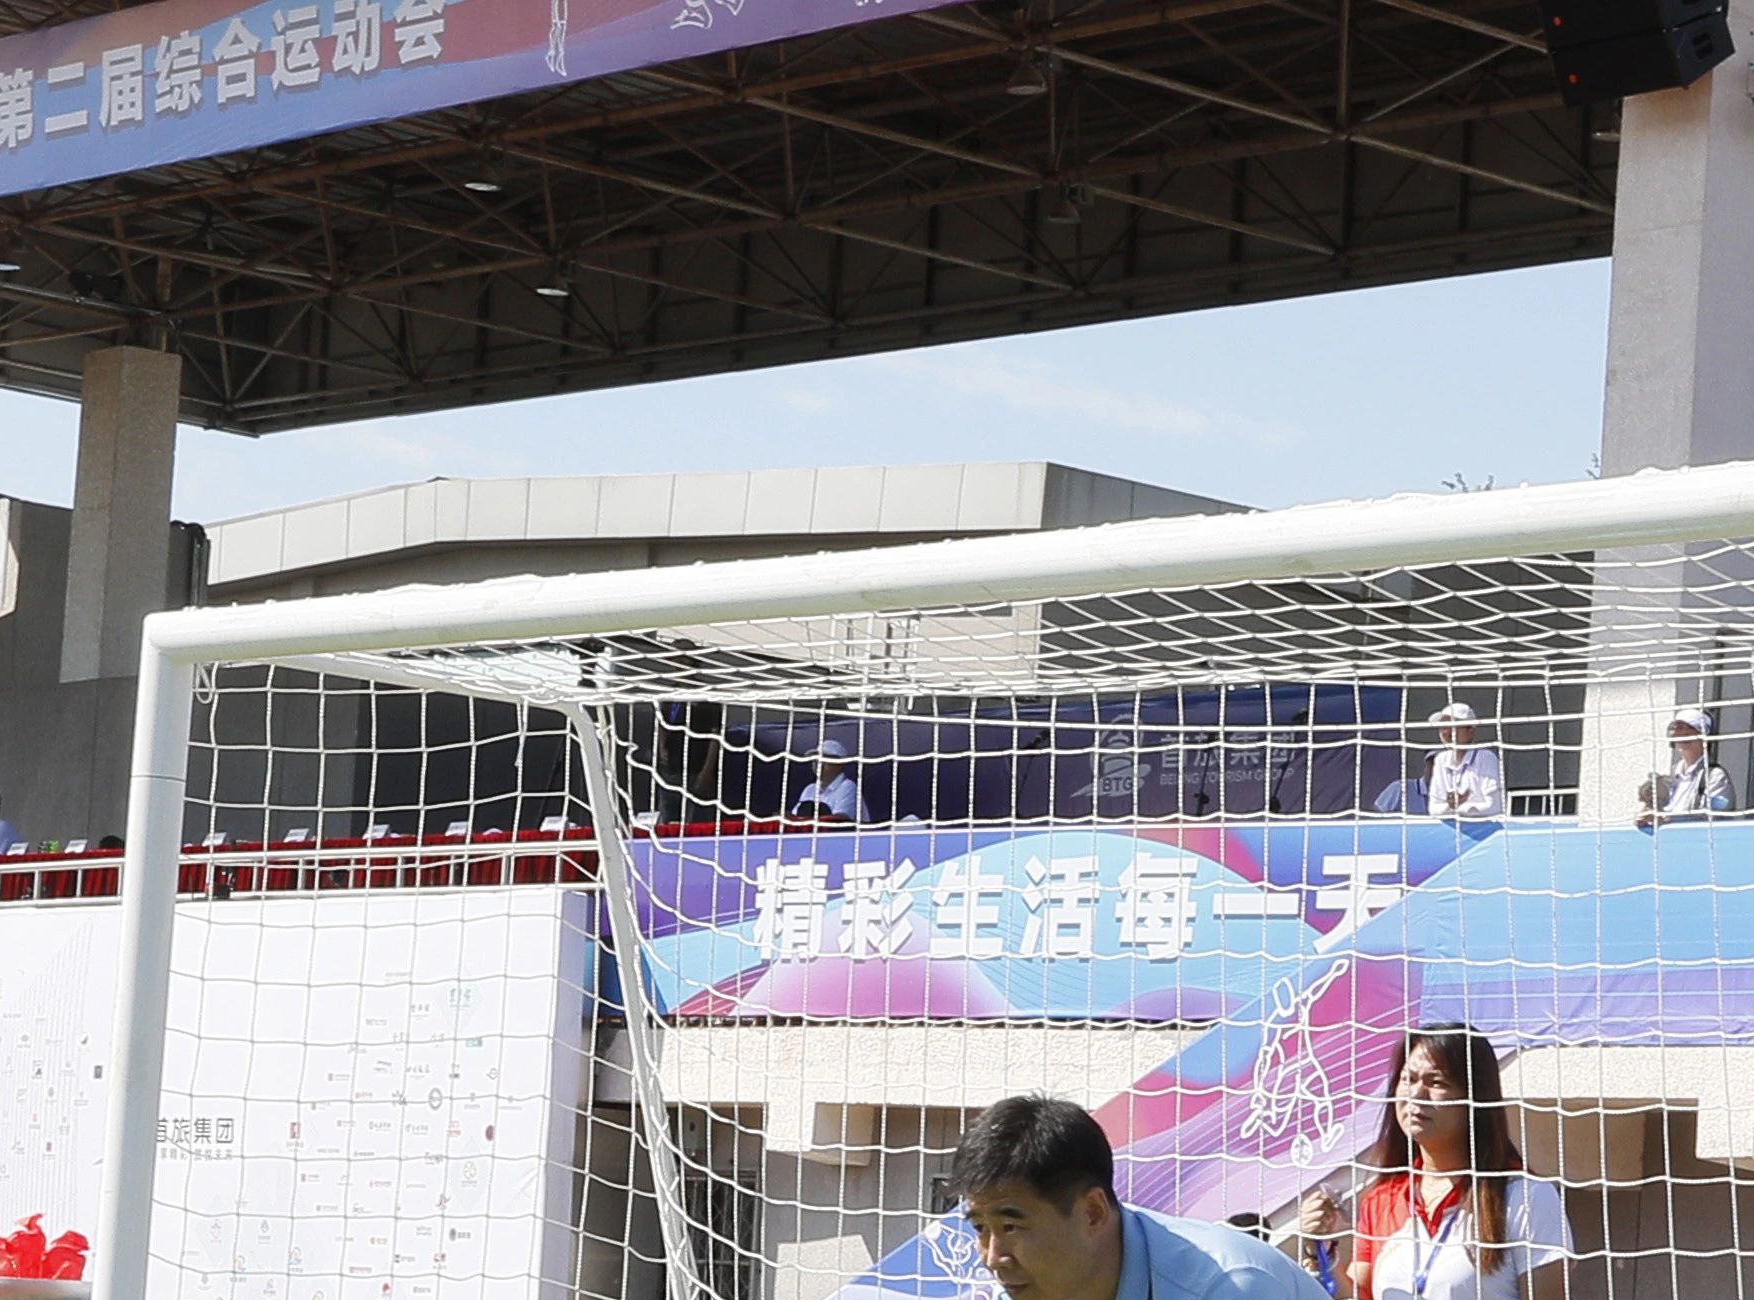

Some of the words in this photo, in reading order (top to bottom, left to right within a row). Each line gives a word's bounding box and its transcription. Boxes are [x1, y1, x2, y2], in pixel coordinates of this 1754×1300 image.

[1102, 776, 1133, 793] BTG
[752, 853, 1401, 960] 精彩生活每一天
